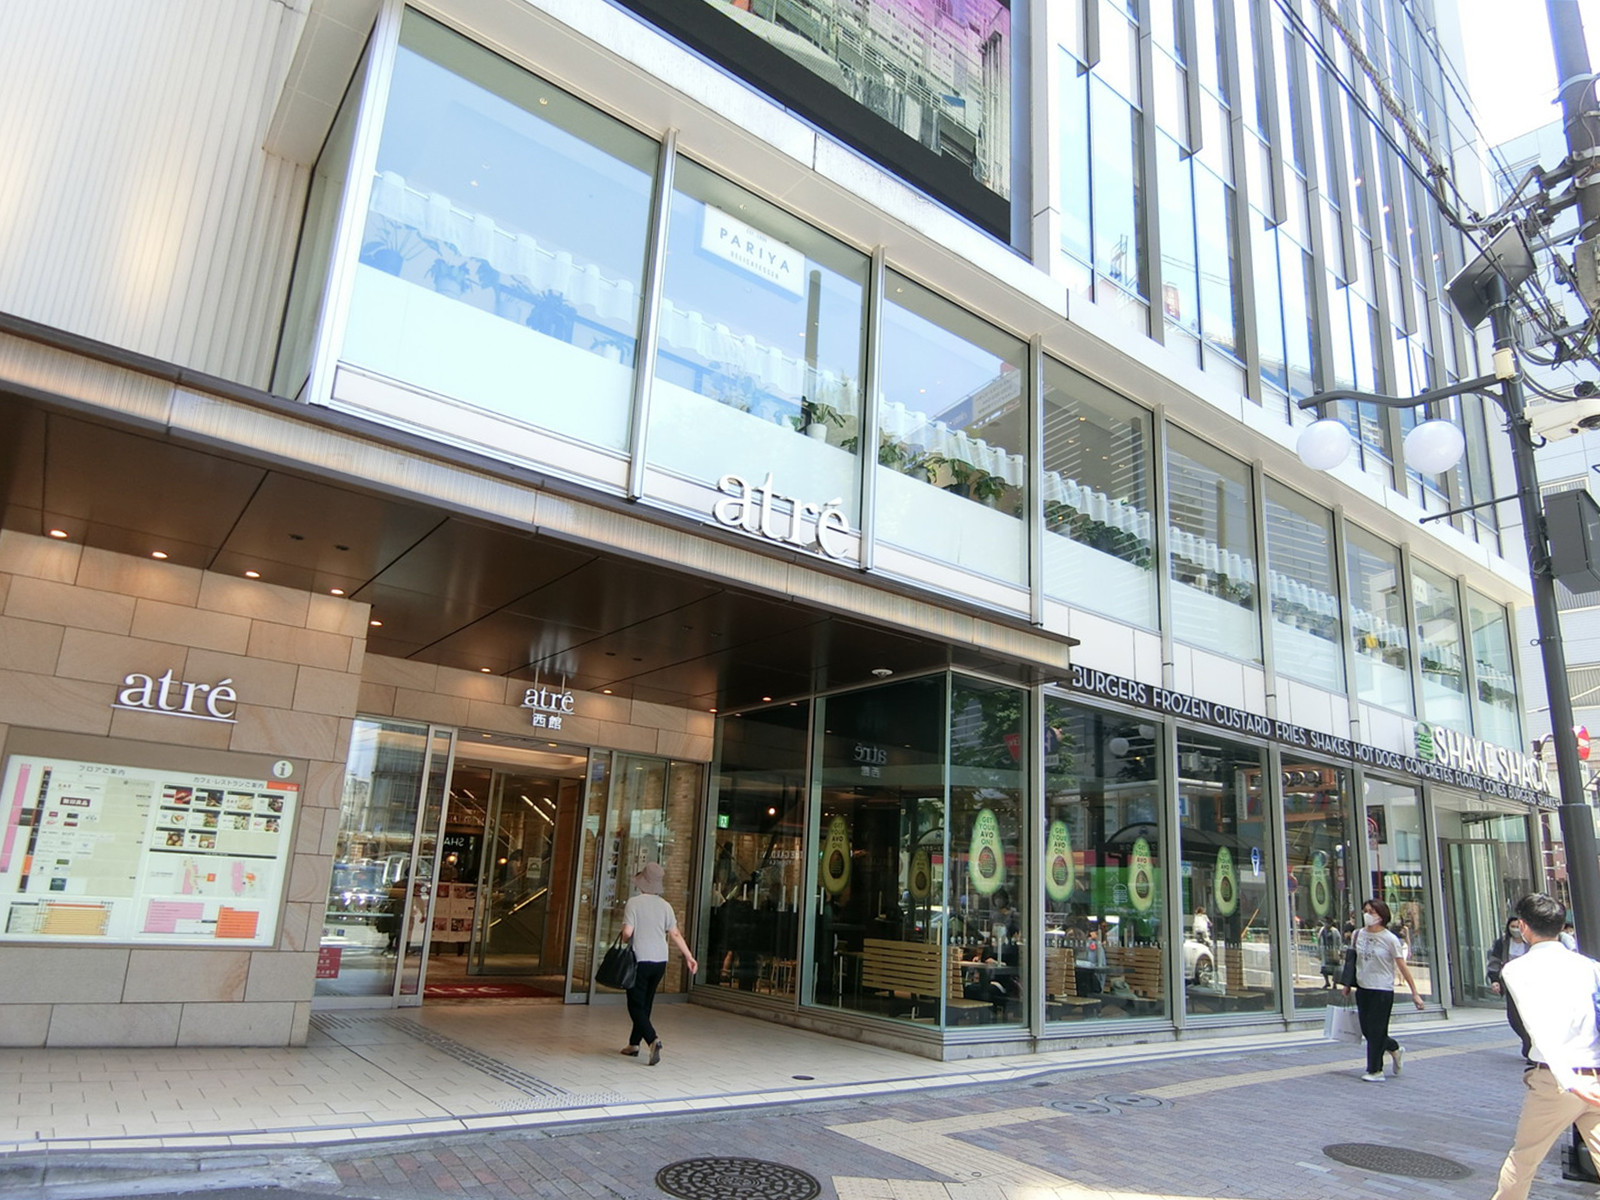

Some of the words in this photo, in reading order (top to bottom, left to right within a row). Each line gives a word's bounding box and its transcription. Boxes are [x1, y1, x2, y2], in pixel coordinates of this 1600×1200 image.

[719, 227, 790, 273] PARIYA
[712, 472, 850, 559] atré
[119, 668, 237, 718] atré
[524, 686, 575, 713] atré
[532, 712, 562, 730] 西館
[1072, 665, 1147, 704] BURGERS
[1153, 687, 1210, 720] FROZEN
[1213, 705, 1271, 736] CUSTARD
[1275, 721, 1306, 746] FRIES
[1310, 731, 1351, 757] SHAKES
[1353, 743, 1374, 763] HOT
[1375, 749, 1402, 770] DOGS
[1404, 757, 1454, 784] CONCRETES
[1455, 771, 1482, 791] FLOATS
[1483, 779, 1507, 797] CONES
[1433, 725, 1496, 779] SHAKE
[1497, 746, 1553, 796] SHACK
[980, 831, 994, 839] AVO
[981, 816, 993, 824] GET
[1053, 841, 1066, 849] AVO
